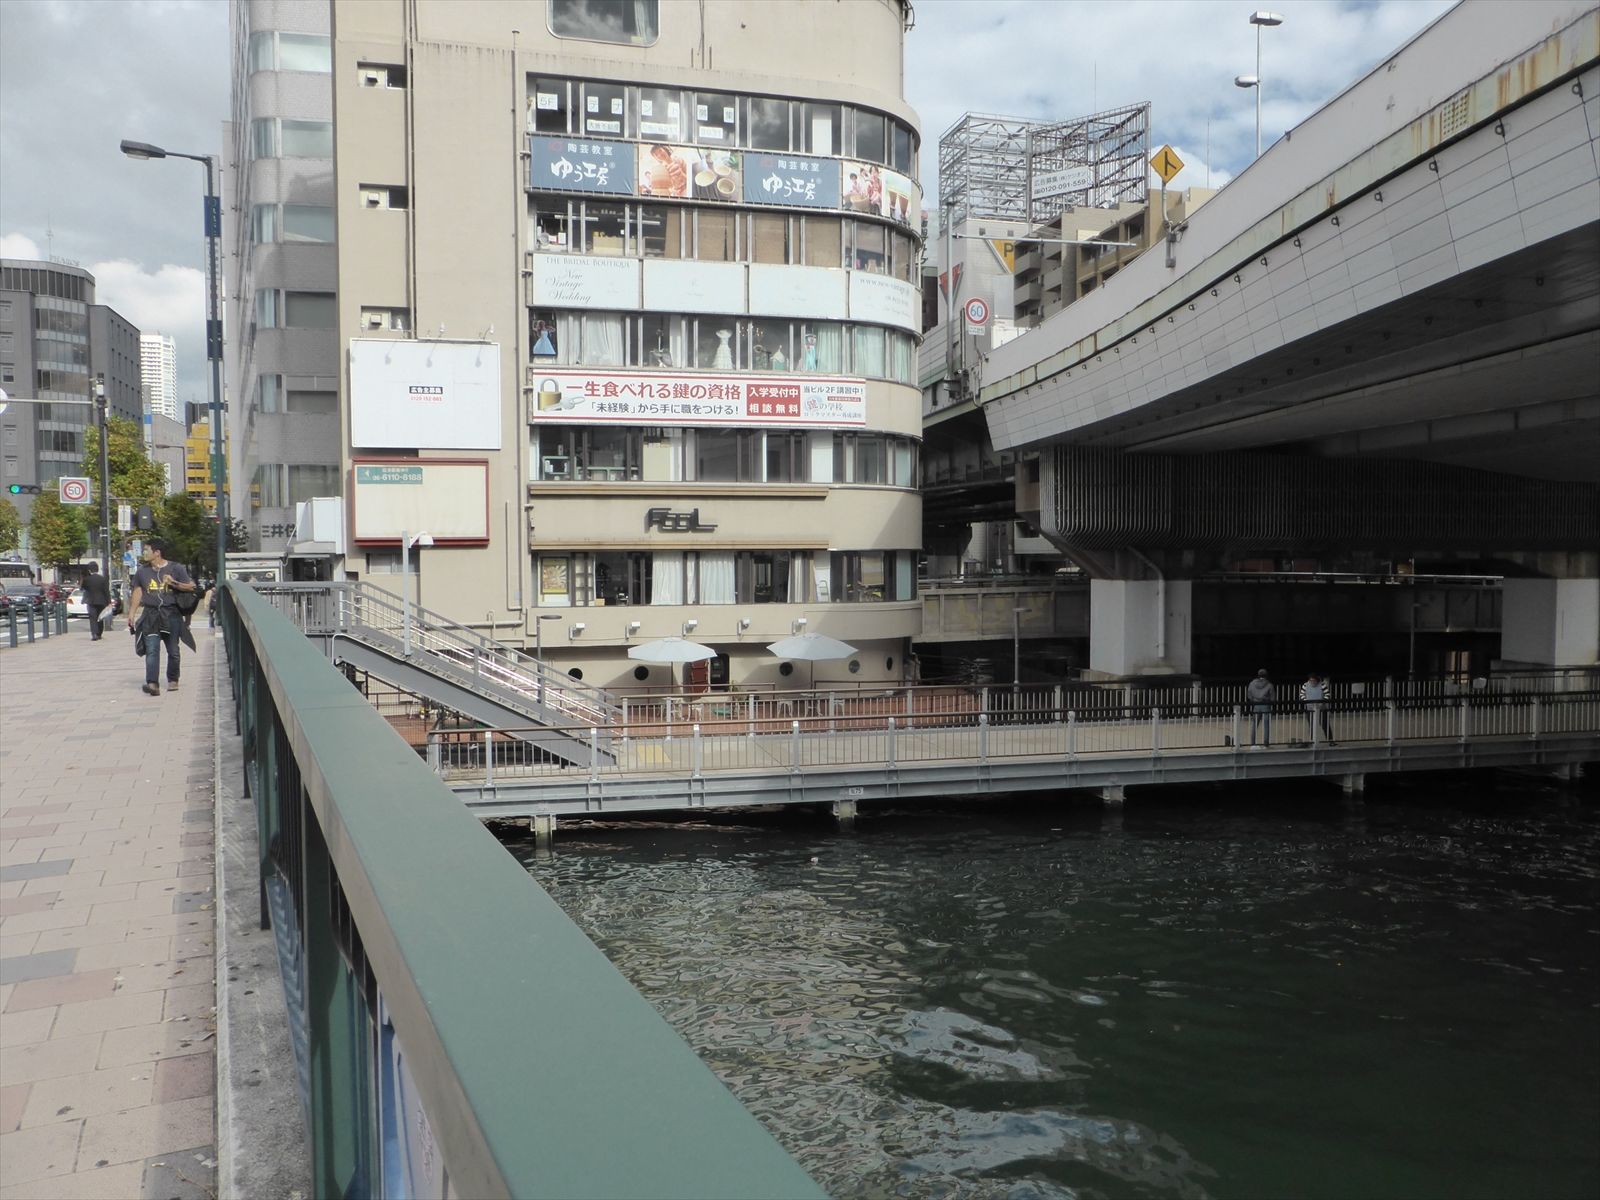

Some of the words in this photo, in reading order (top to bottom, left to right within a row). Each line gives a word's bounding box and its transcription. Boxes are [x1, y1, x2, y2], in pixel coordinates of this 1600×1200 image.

[567, 143, 613, 155] 陶芸教室
[551, 156, 609, 186] ゆう工房
[778, 160, 819, 172] 陶芸教室
[762, 172, 816, 200] ゆう工房
[1004, 242, 1014, 258] P
[970, 305, 983, 317] 60
[566, 381, 741, 400] 一生食べれる鍵の資格
[749, 387, 799, 398] 入学受付中
[749, 403, 799, 414] 相談無料
[68, 487, 80, 495] 50
